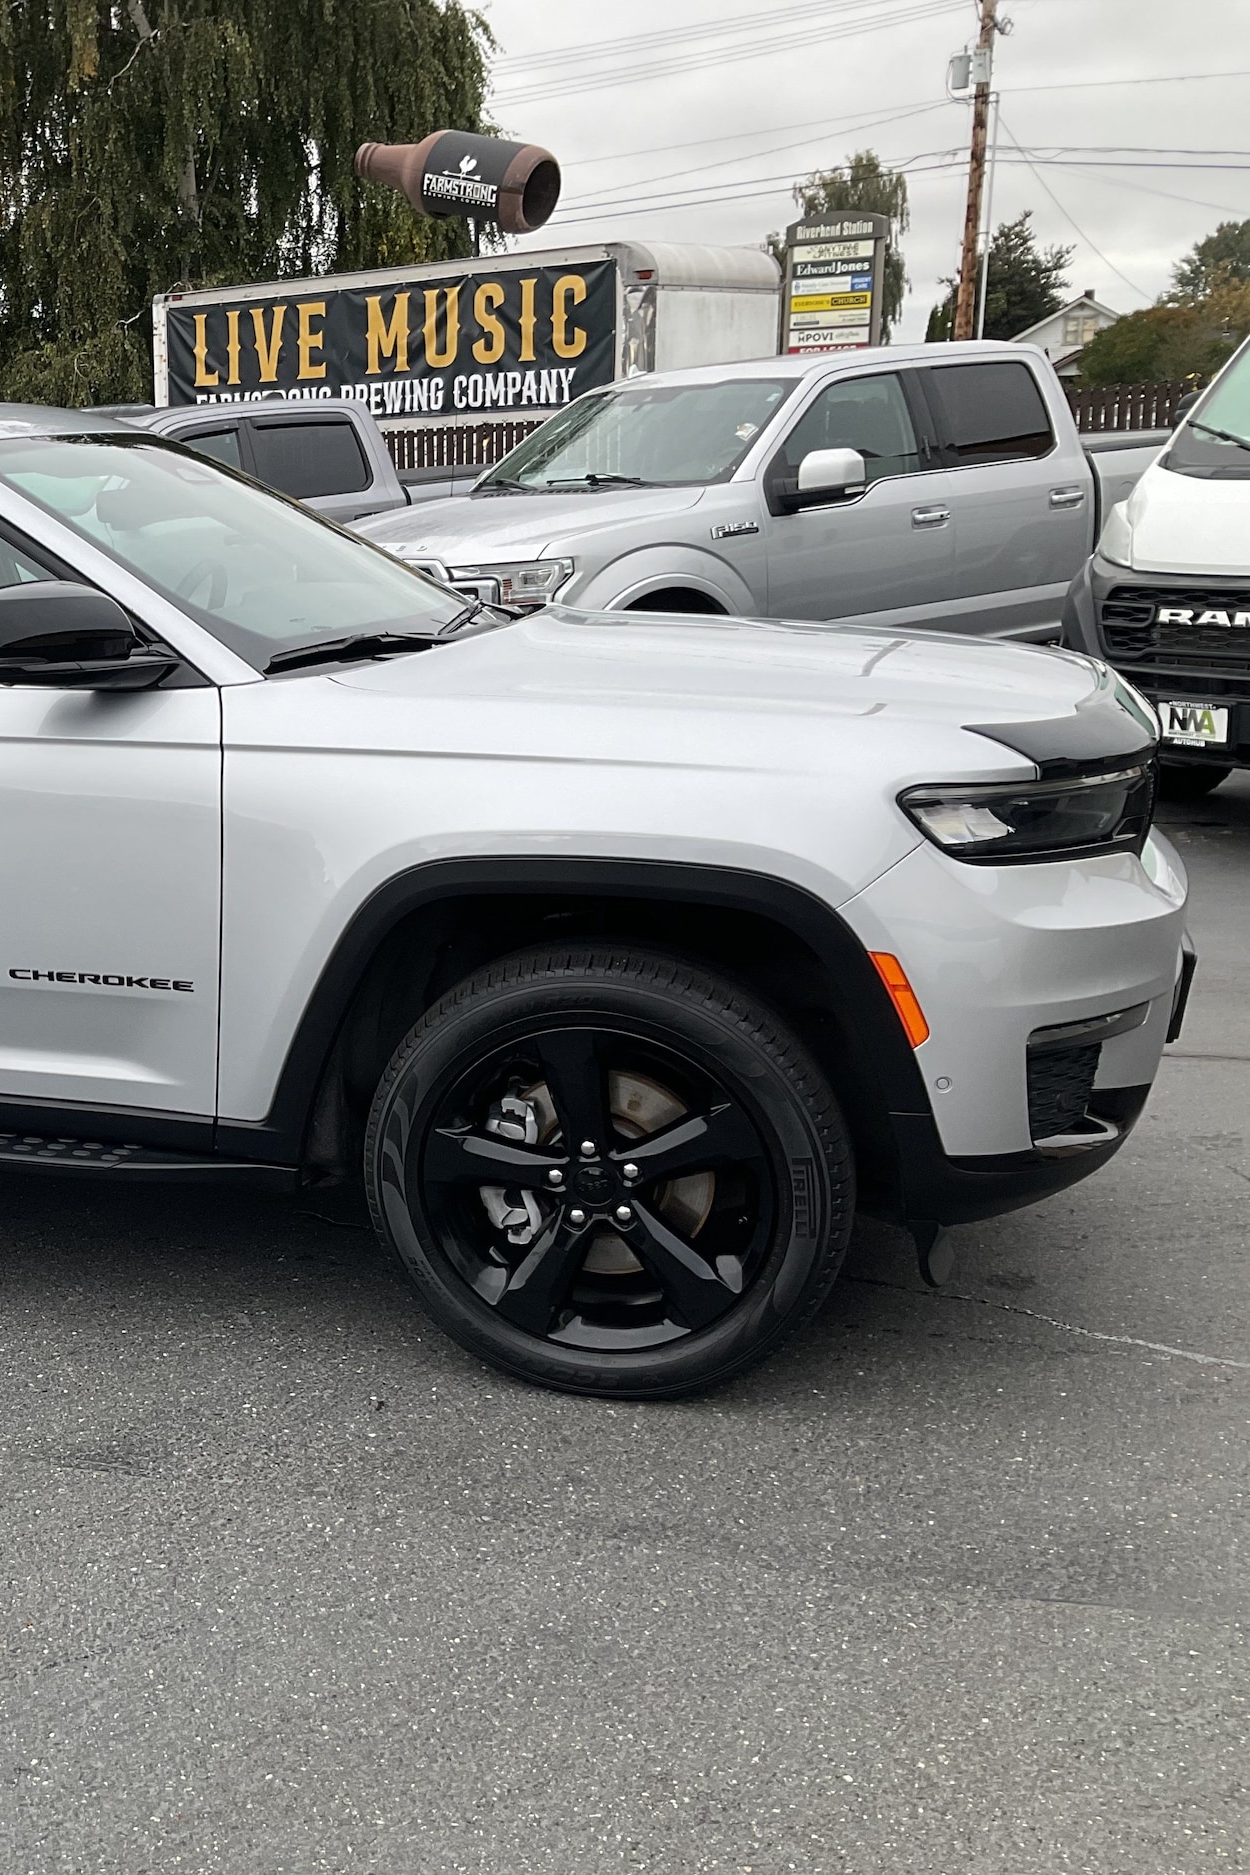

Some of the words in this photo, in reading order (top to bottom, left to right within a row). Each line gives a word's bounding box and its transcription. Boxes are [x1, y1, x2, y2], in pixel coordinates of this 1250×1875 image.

[423, 173, 498, 203] FARMSTRONG
[423, 190, 456, 201] BREWING
[460, 197, 496, 208] COMPANY
[843, 220, 874, 235] Station
[832, 295, 866, 306] CHURCH
[193, 301, 327, 387] LIVE
[365, 274, 587, 375] MUSIC
[453, 367, 576, 408] COMPANY
[1169, 708, 1217, 735] NWA
[1173, 738, 1206, 747] AUTOHUB
[8, 968, 195, 992] CHEROKEE
[792, 1157, 817, 1239] PIRELLI
